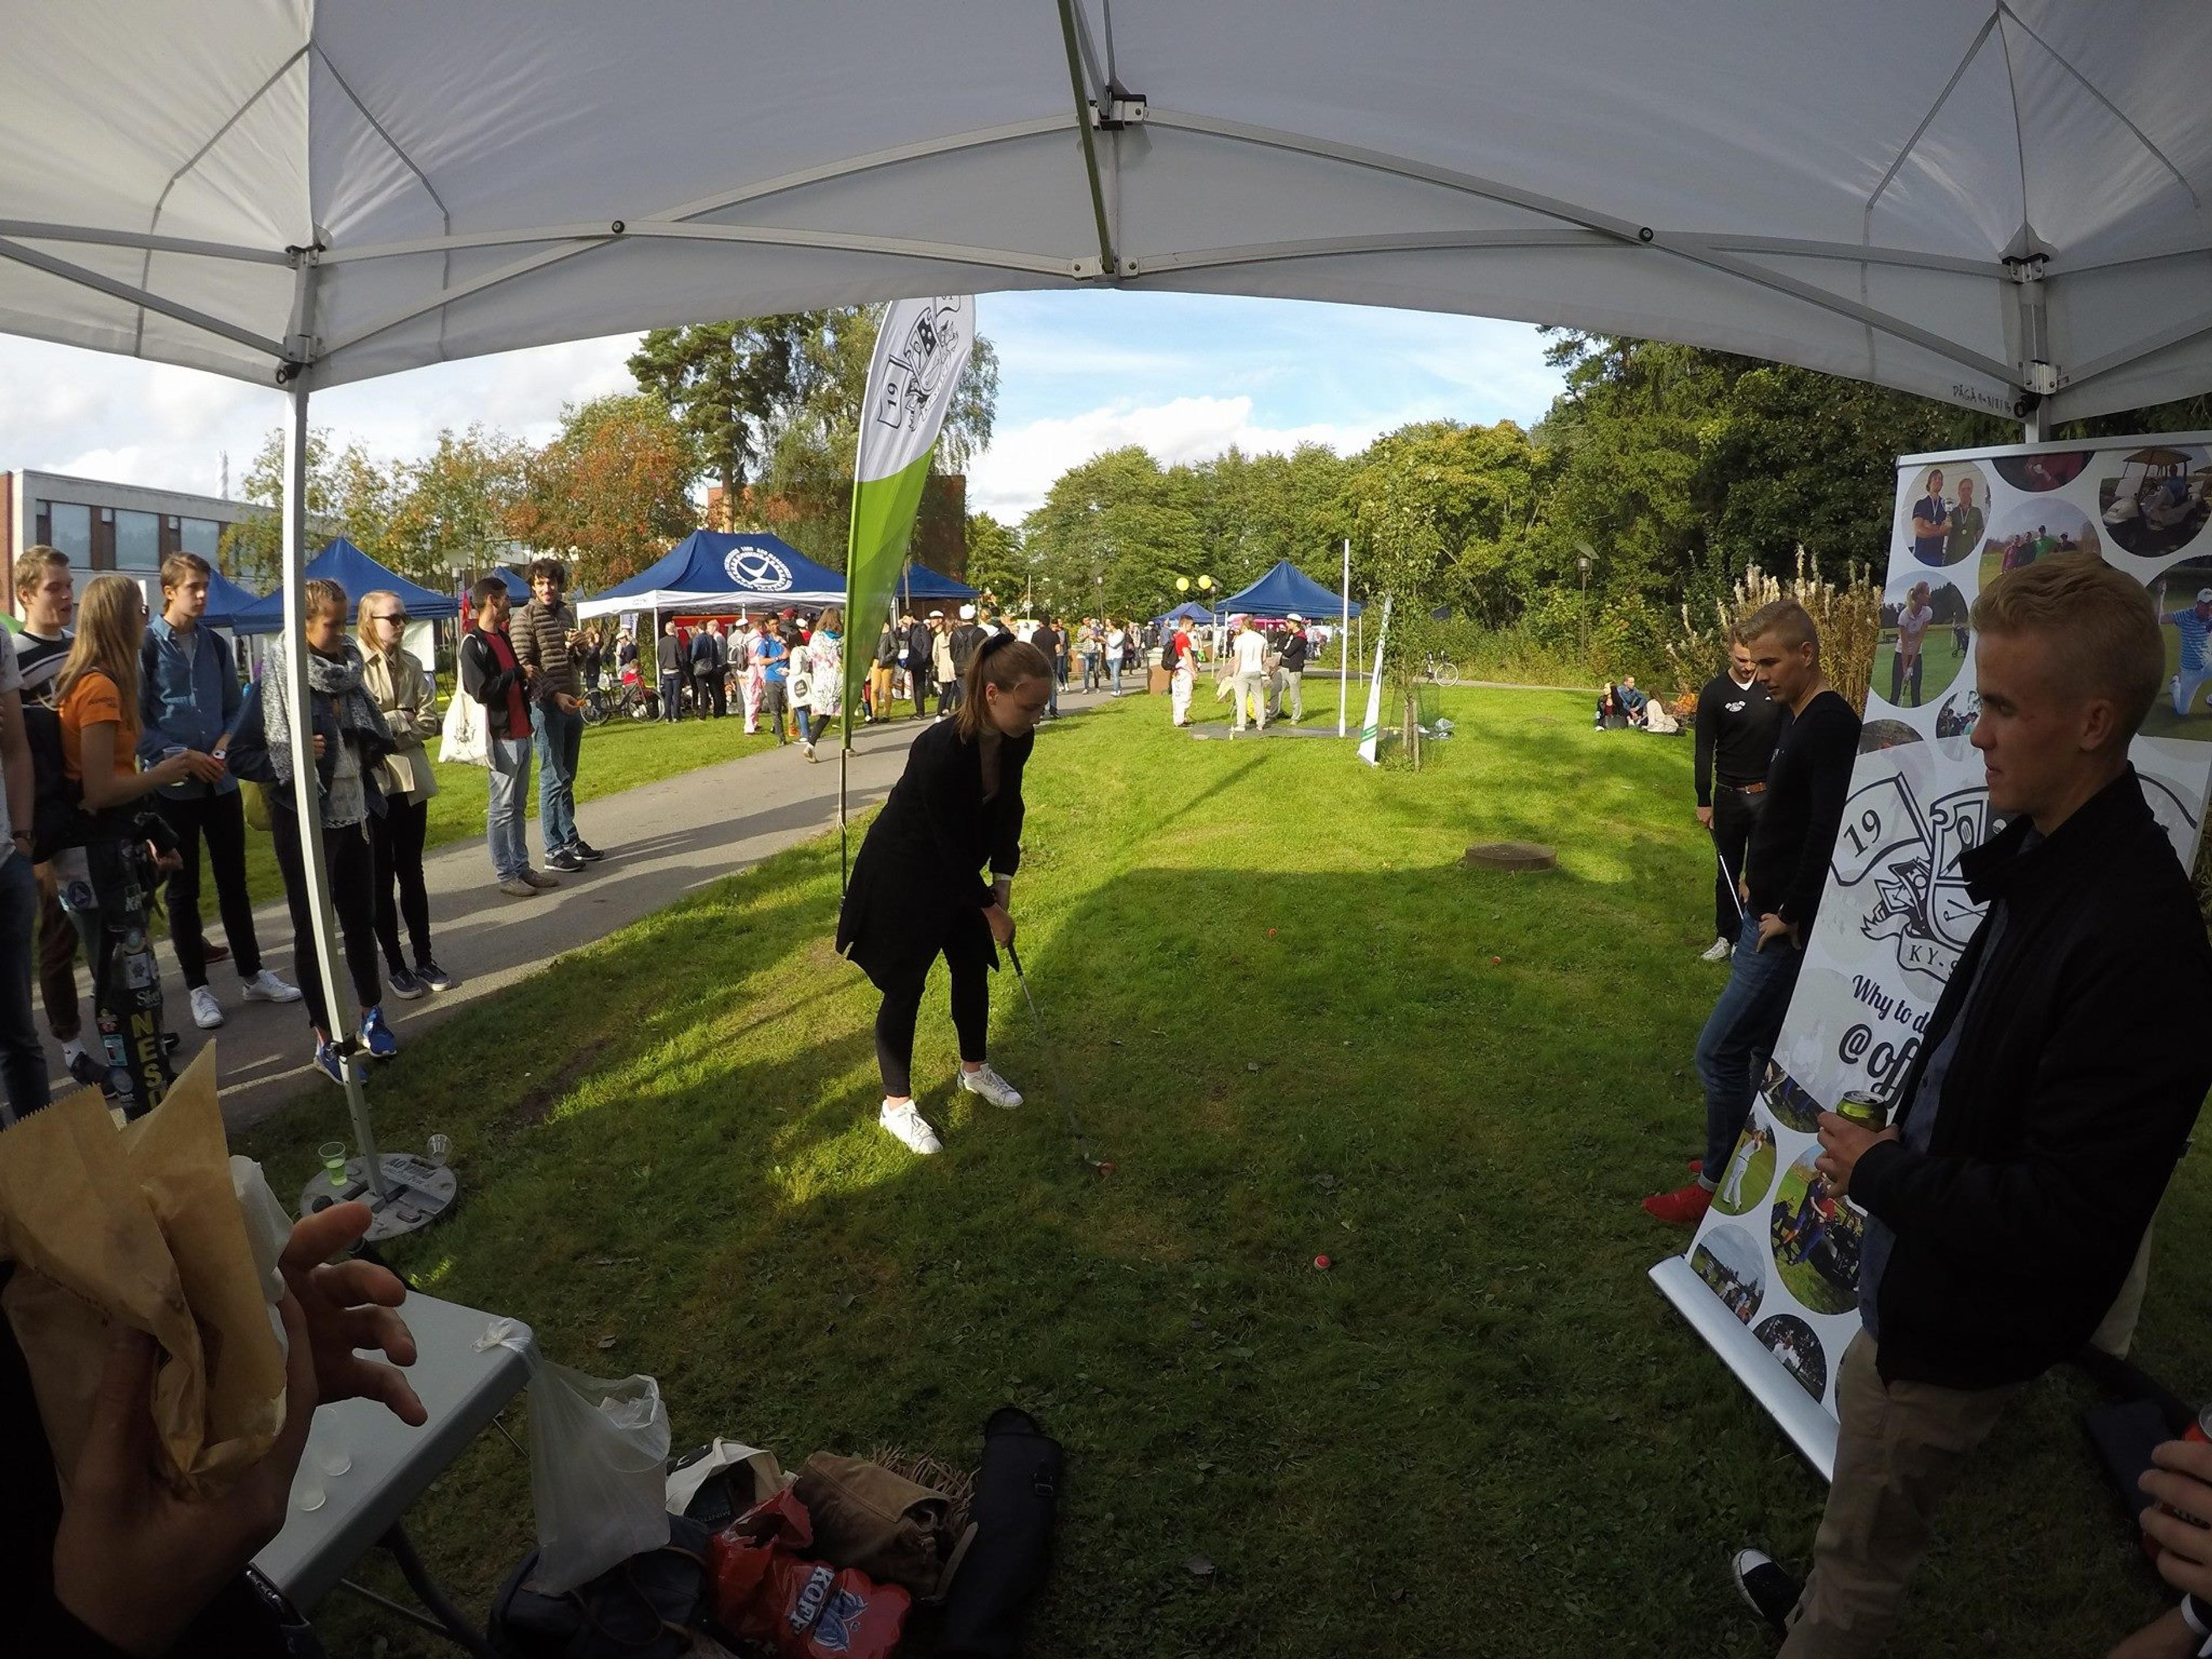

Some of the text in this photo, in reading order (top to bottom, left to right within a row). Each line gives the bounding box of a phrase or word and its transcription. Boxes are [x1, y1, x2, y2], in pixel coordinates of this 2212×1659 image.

[887, 382, 899, 407] 19
[1843, 809, 1881, 858] 19
[1853, 975, 1930, 1034] Why to d
